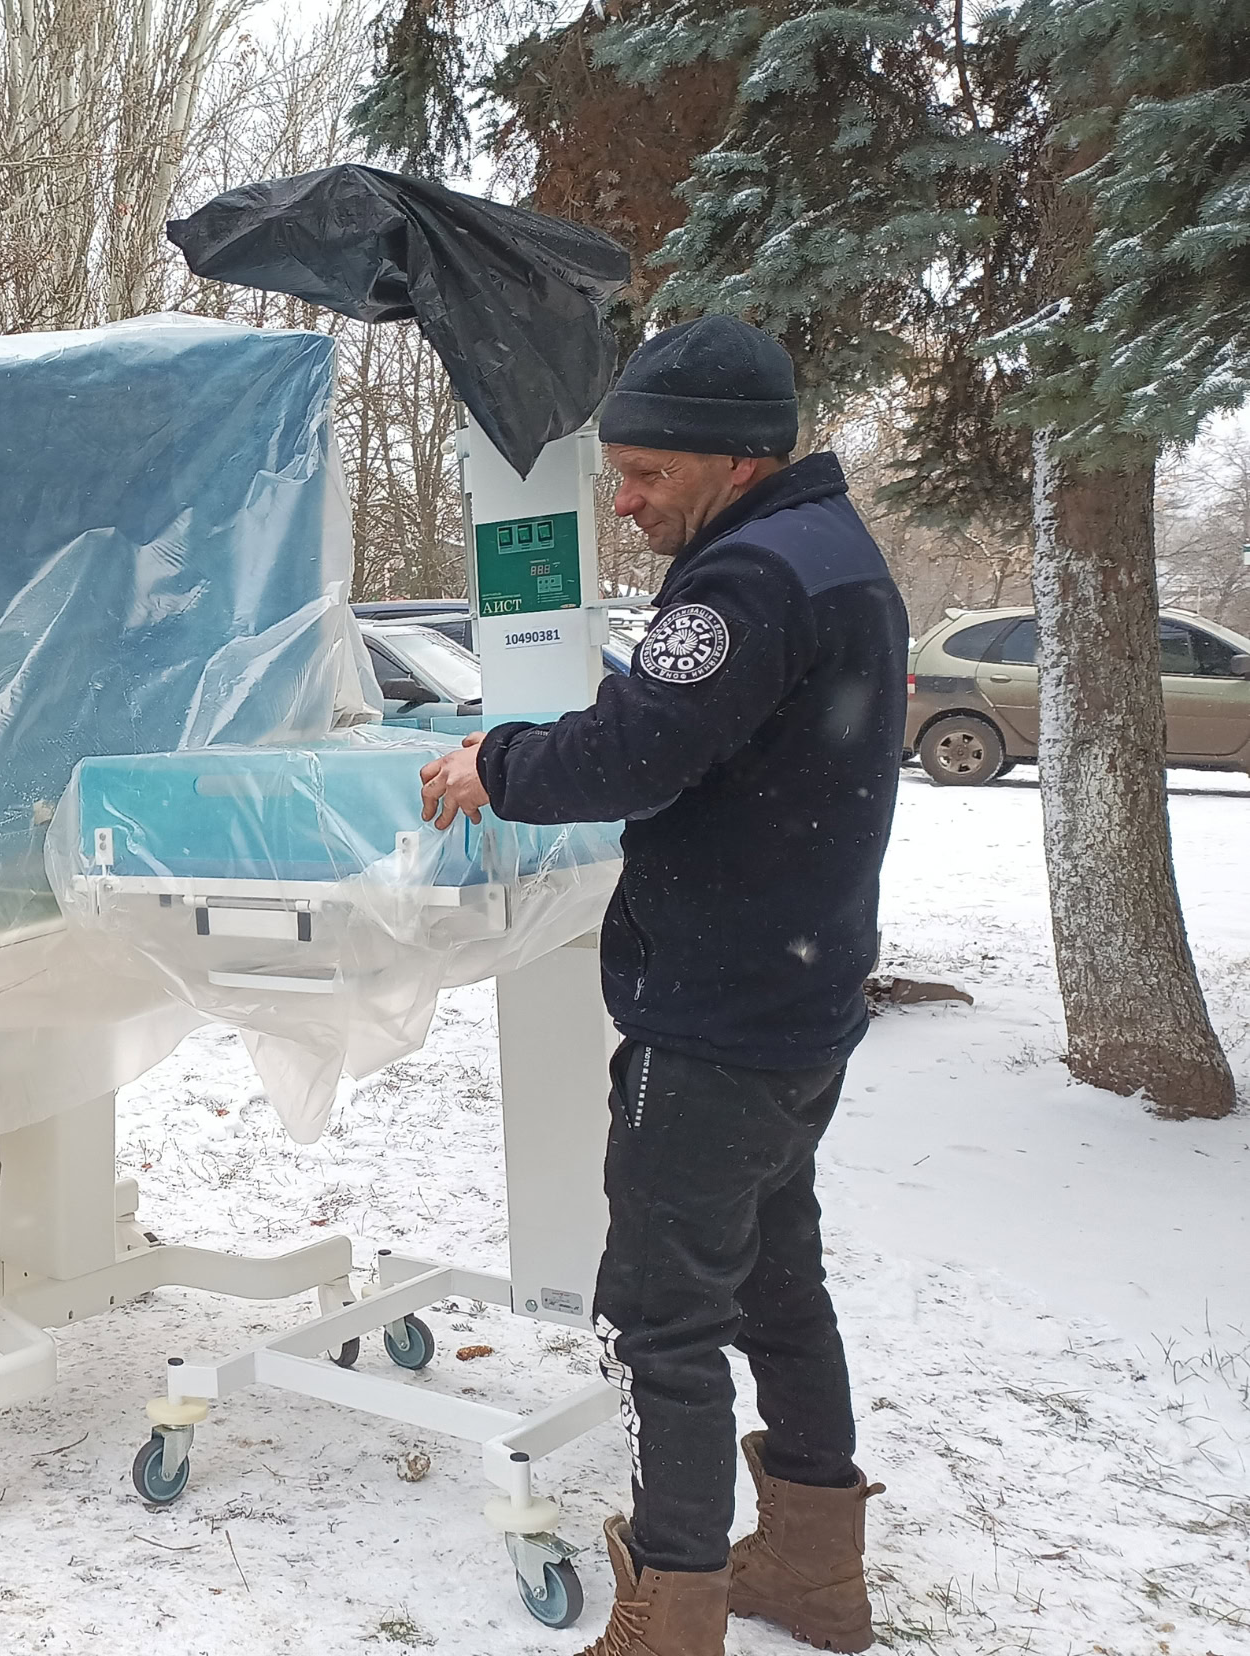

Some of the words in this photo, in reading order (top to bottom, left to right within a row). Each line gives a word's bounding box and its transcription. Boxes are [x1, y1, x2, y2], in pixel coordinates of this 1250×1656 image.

[482, 598, 522, 614] АИСТ
[505, 629, 560, 645] 10490381
[652, 626, 712, 670] ПОРУЧ
